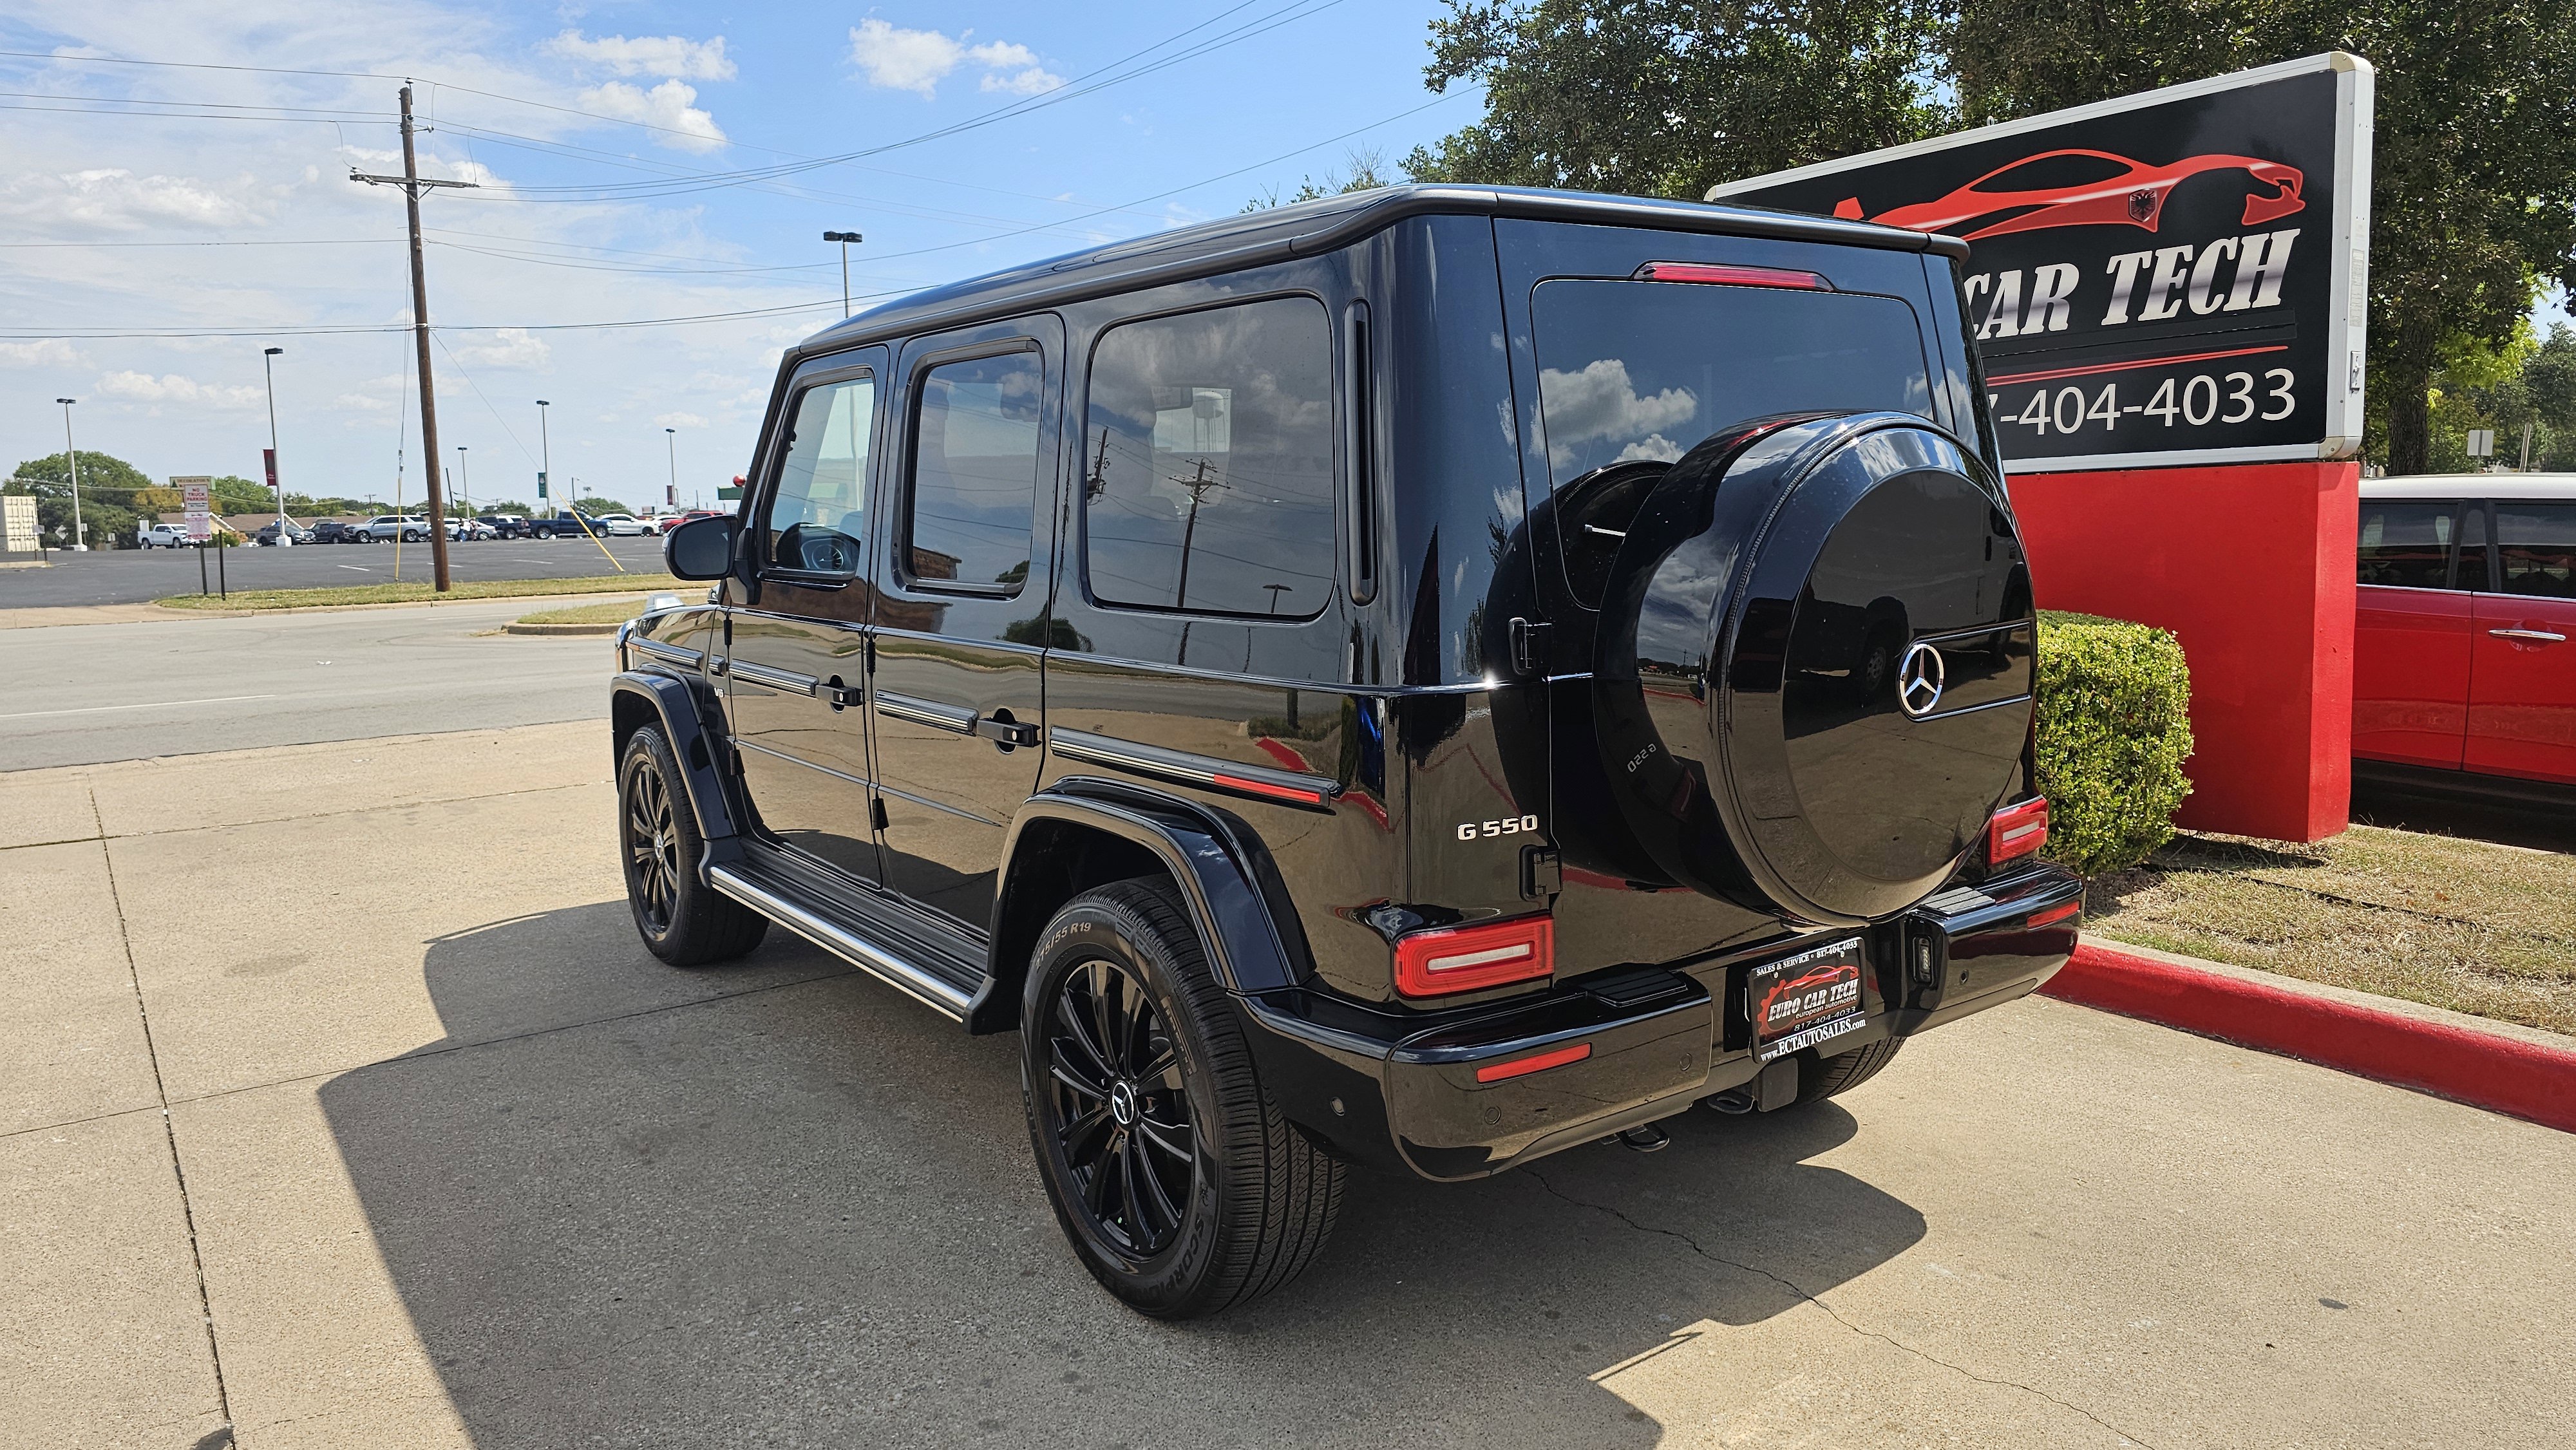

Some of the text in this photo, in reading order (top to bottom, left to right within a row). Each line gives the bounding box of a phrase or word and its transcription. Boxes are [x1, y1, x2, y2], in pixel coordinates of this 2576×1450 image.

[1964, 263, 2079, 340] CAR
[2101, 229, 2301, 326] TECH
[1989, 368, 2295, 436] -404-4033
[1457, 814, 1538, 841] G 550
[1070, 921, 1092, 934] R19
[1756, 965, 1776, 976] SALES
[1783, 954, 1810, 968] SERVICE
[1816, 940, 1858, 959] 817-404-4033
[1767, 978, 1859, 1022] EURO CAR TECH
[1795, 995, 1857, 1020] european automotive
[1794, 1006, 1856, 1031] 817-404-4033
[1760, 1018, 1866, 1062] www.ECTAUTOSALES.com
